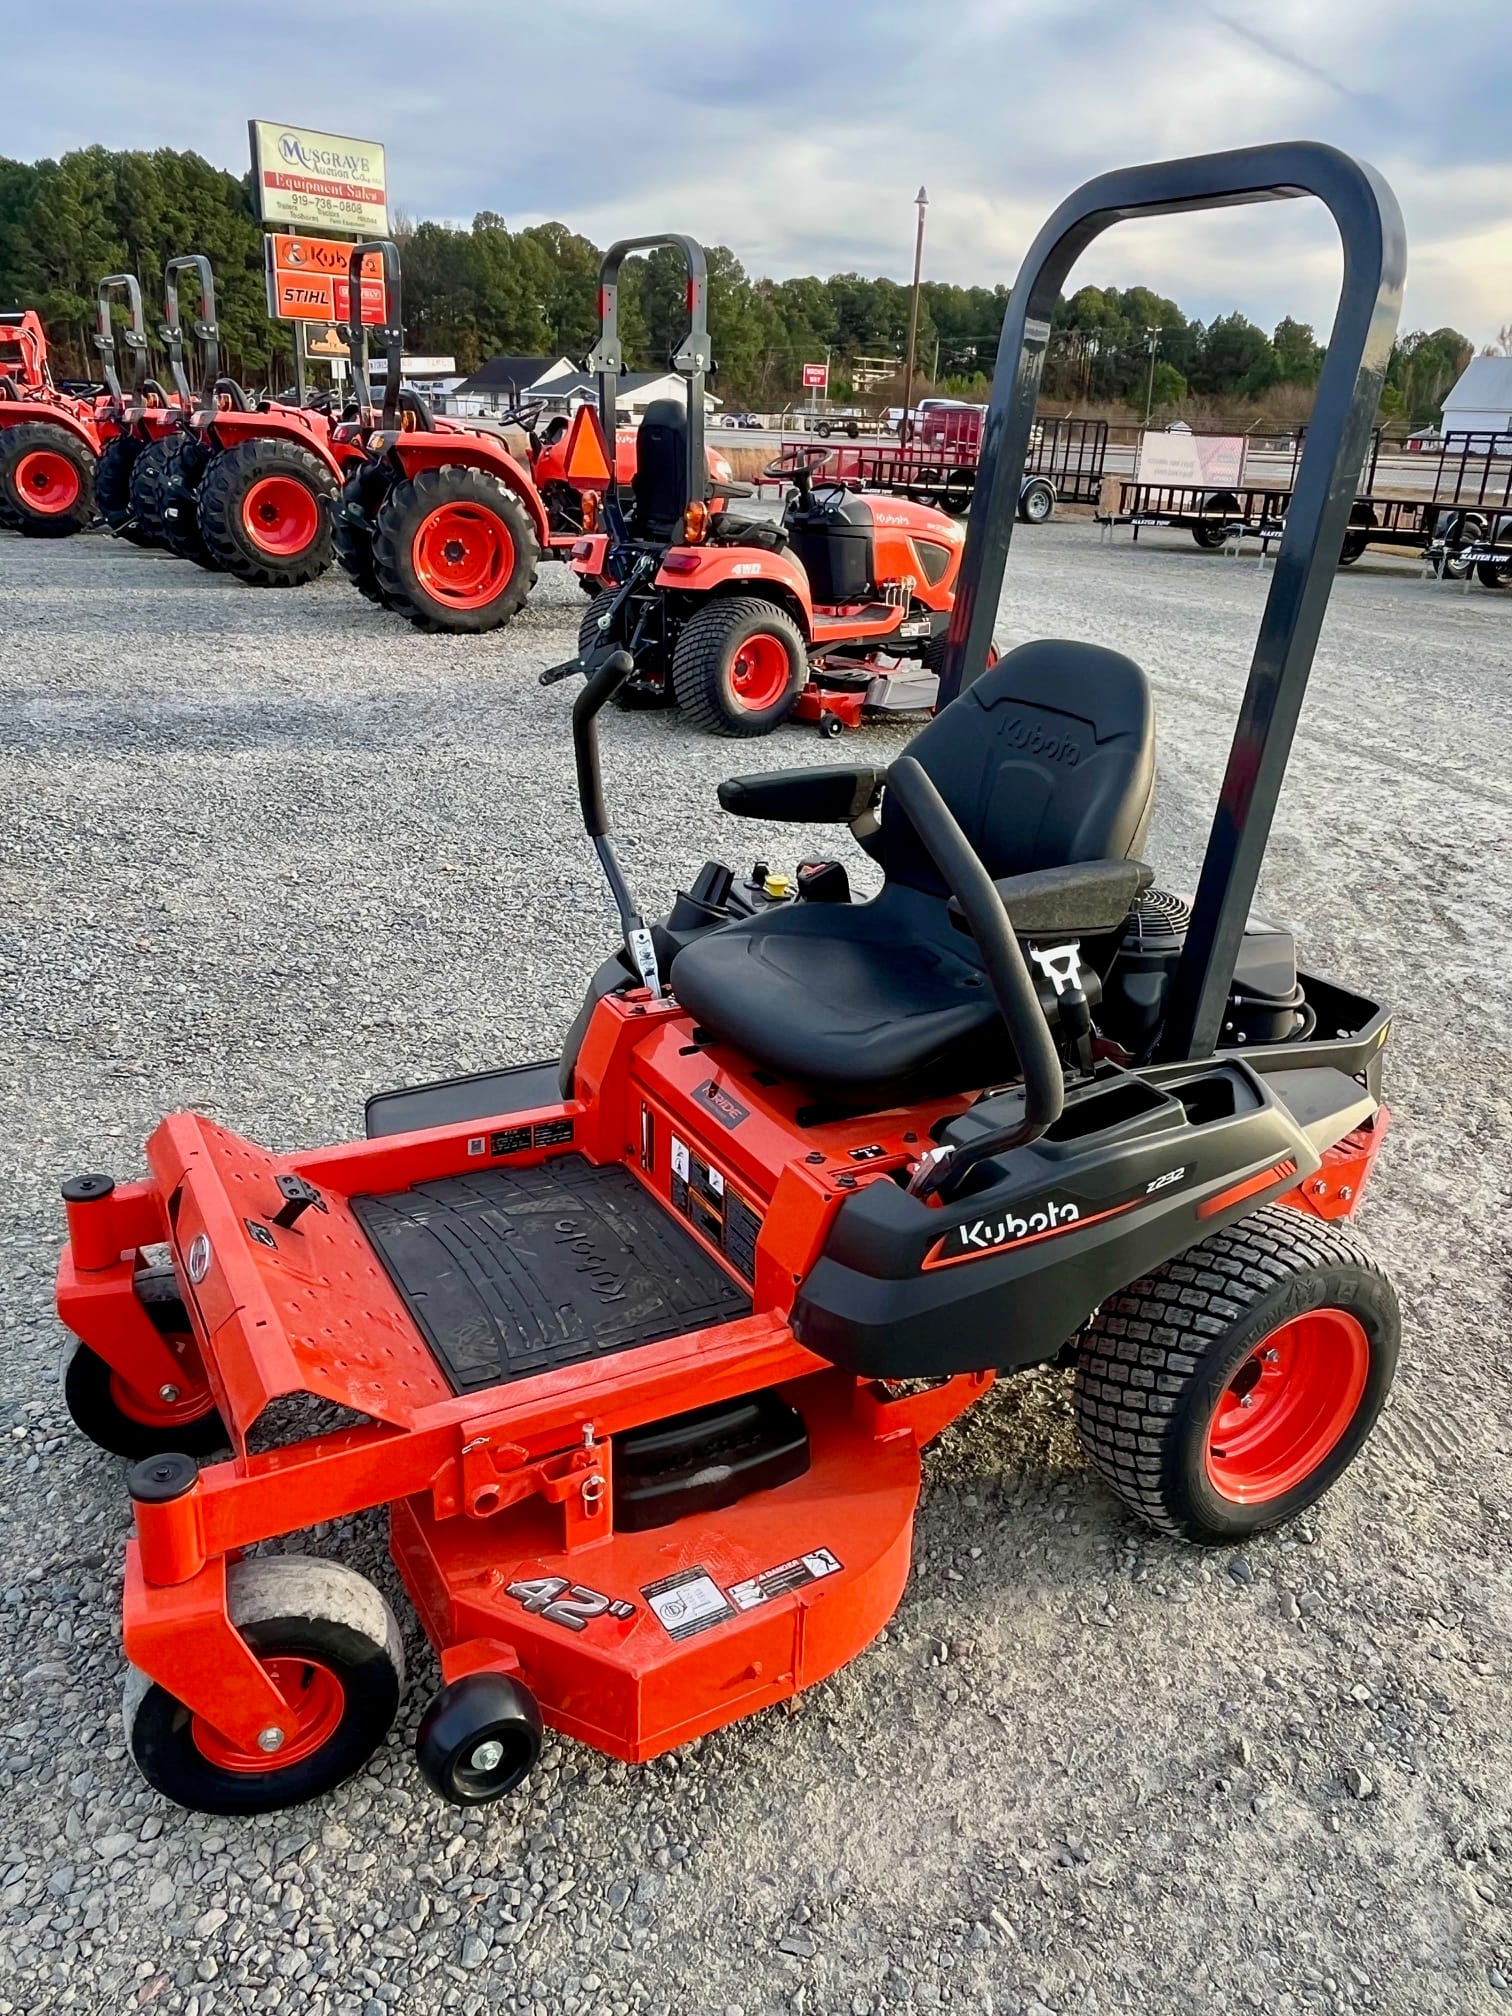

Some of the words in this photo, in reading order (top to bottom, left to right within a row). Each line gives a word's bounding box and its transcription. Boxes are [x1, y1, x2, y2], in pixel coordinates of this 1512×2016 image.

[283, 139, 370, 172] MUSGRAVE
[312, 160, 350, 179] Auction
[275, 172, 343, 197] Equipment
[347, 184, 378, 201] Sales
[292, 193, 363, 215] 919-736-0808
[310, 246, 377, 272] Kuba
[283, 288, 329, 304] STIHL
[875, 513, 910, 525] Kubota
[731, 563, 762, 575] 4WD
[997, 714, 1081, 768] Kubota
[959, 1201, 1080, 1247] Kubota
[554, 1219, 628, 1304] Kubota
[764, 1559, 800, 1578] DANGER
[505, 1576, 637, 1632] 42"
